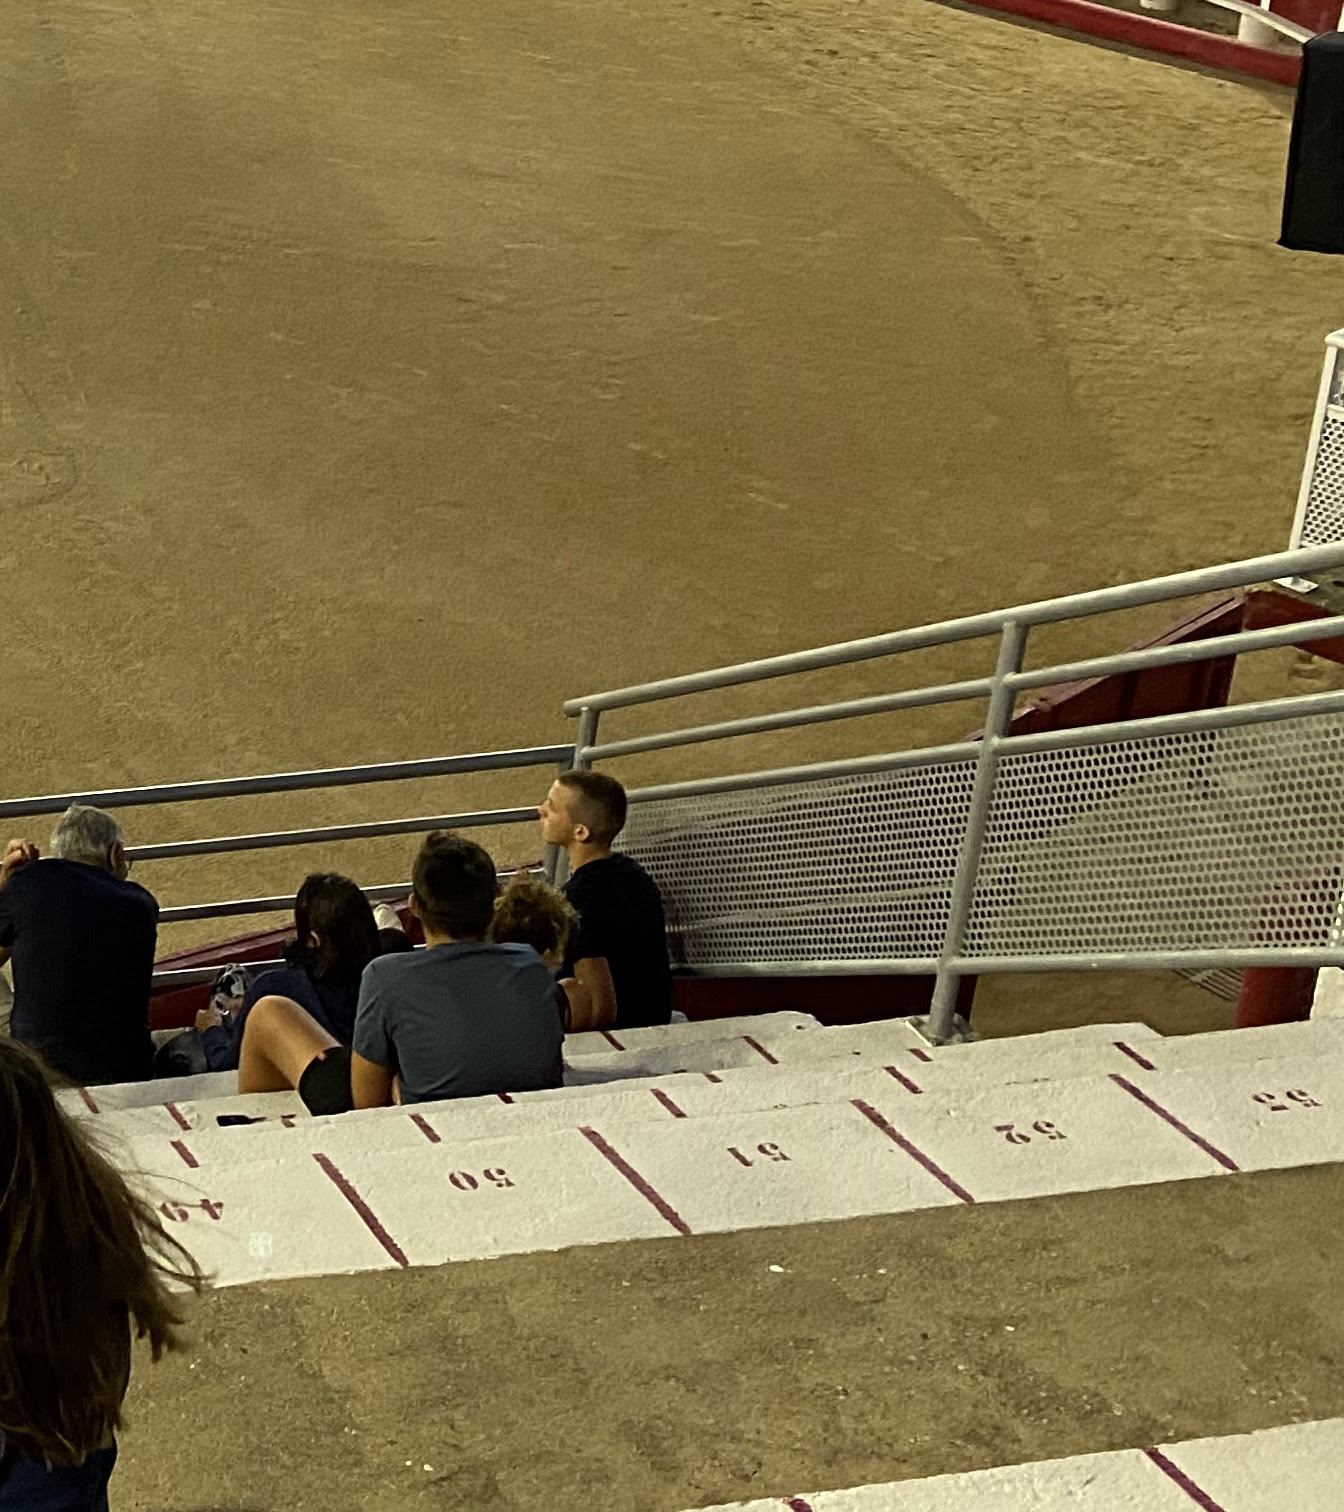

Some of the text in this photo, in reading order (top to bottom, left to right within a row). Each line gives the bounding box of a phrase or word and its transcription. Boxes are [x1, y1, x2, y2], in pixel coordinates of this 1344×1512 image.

[993, 1121, 1067, 1144] 52
[727, 1142, 792, 1167] 51
[448, 1168, 515, 1191] 50
[159, 1198, 223, 1222] 49
